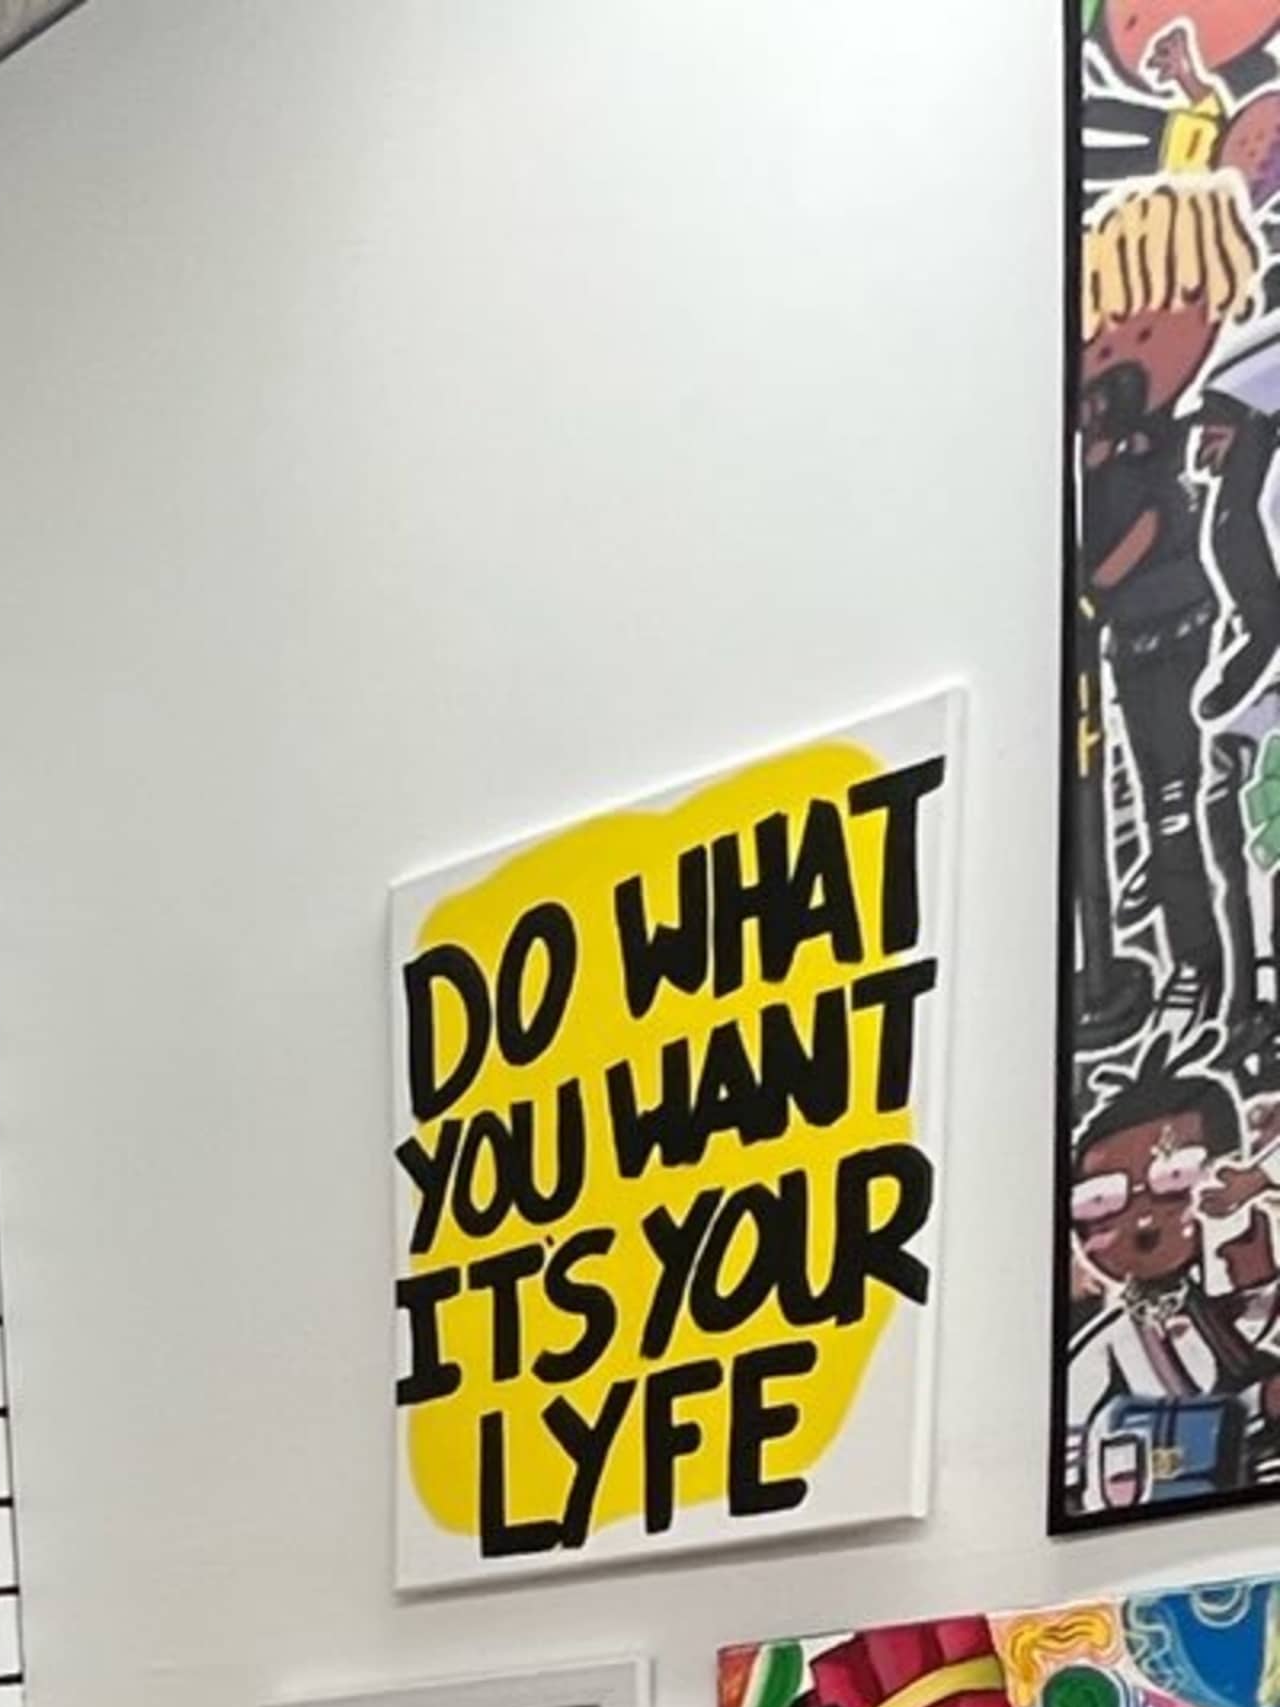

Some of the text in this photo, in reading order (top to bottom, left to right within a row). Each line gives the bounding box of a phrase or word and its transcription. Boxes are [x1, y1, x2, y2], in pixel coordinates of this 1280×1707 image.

[403, 755, 946, 1124] DO WHAT
[395, 958, 938, 1255] YOU WANT
[638, 1142, 936, 1360] YOUR
[477, 1340, 818, 1558] LYFE
